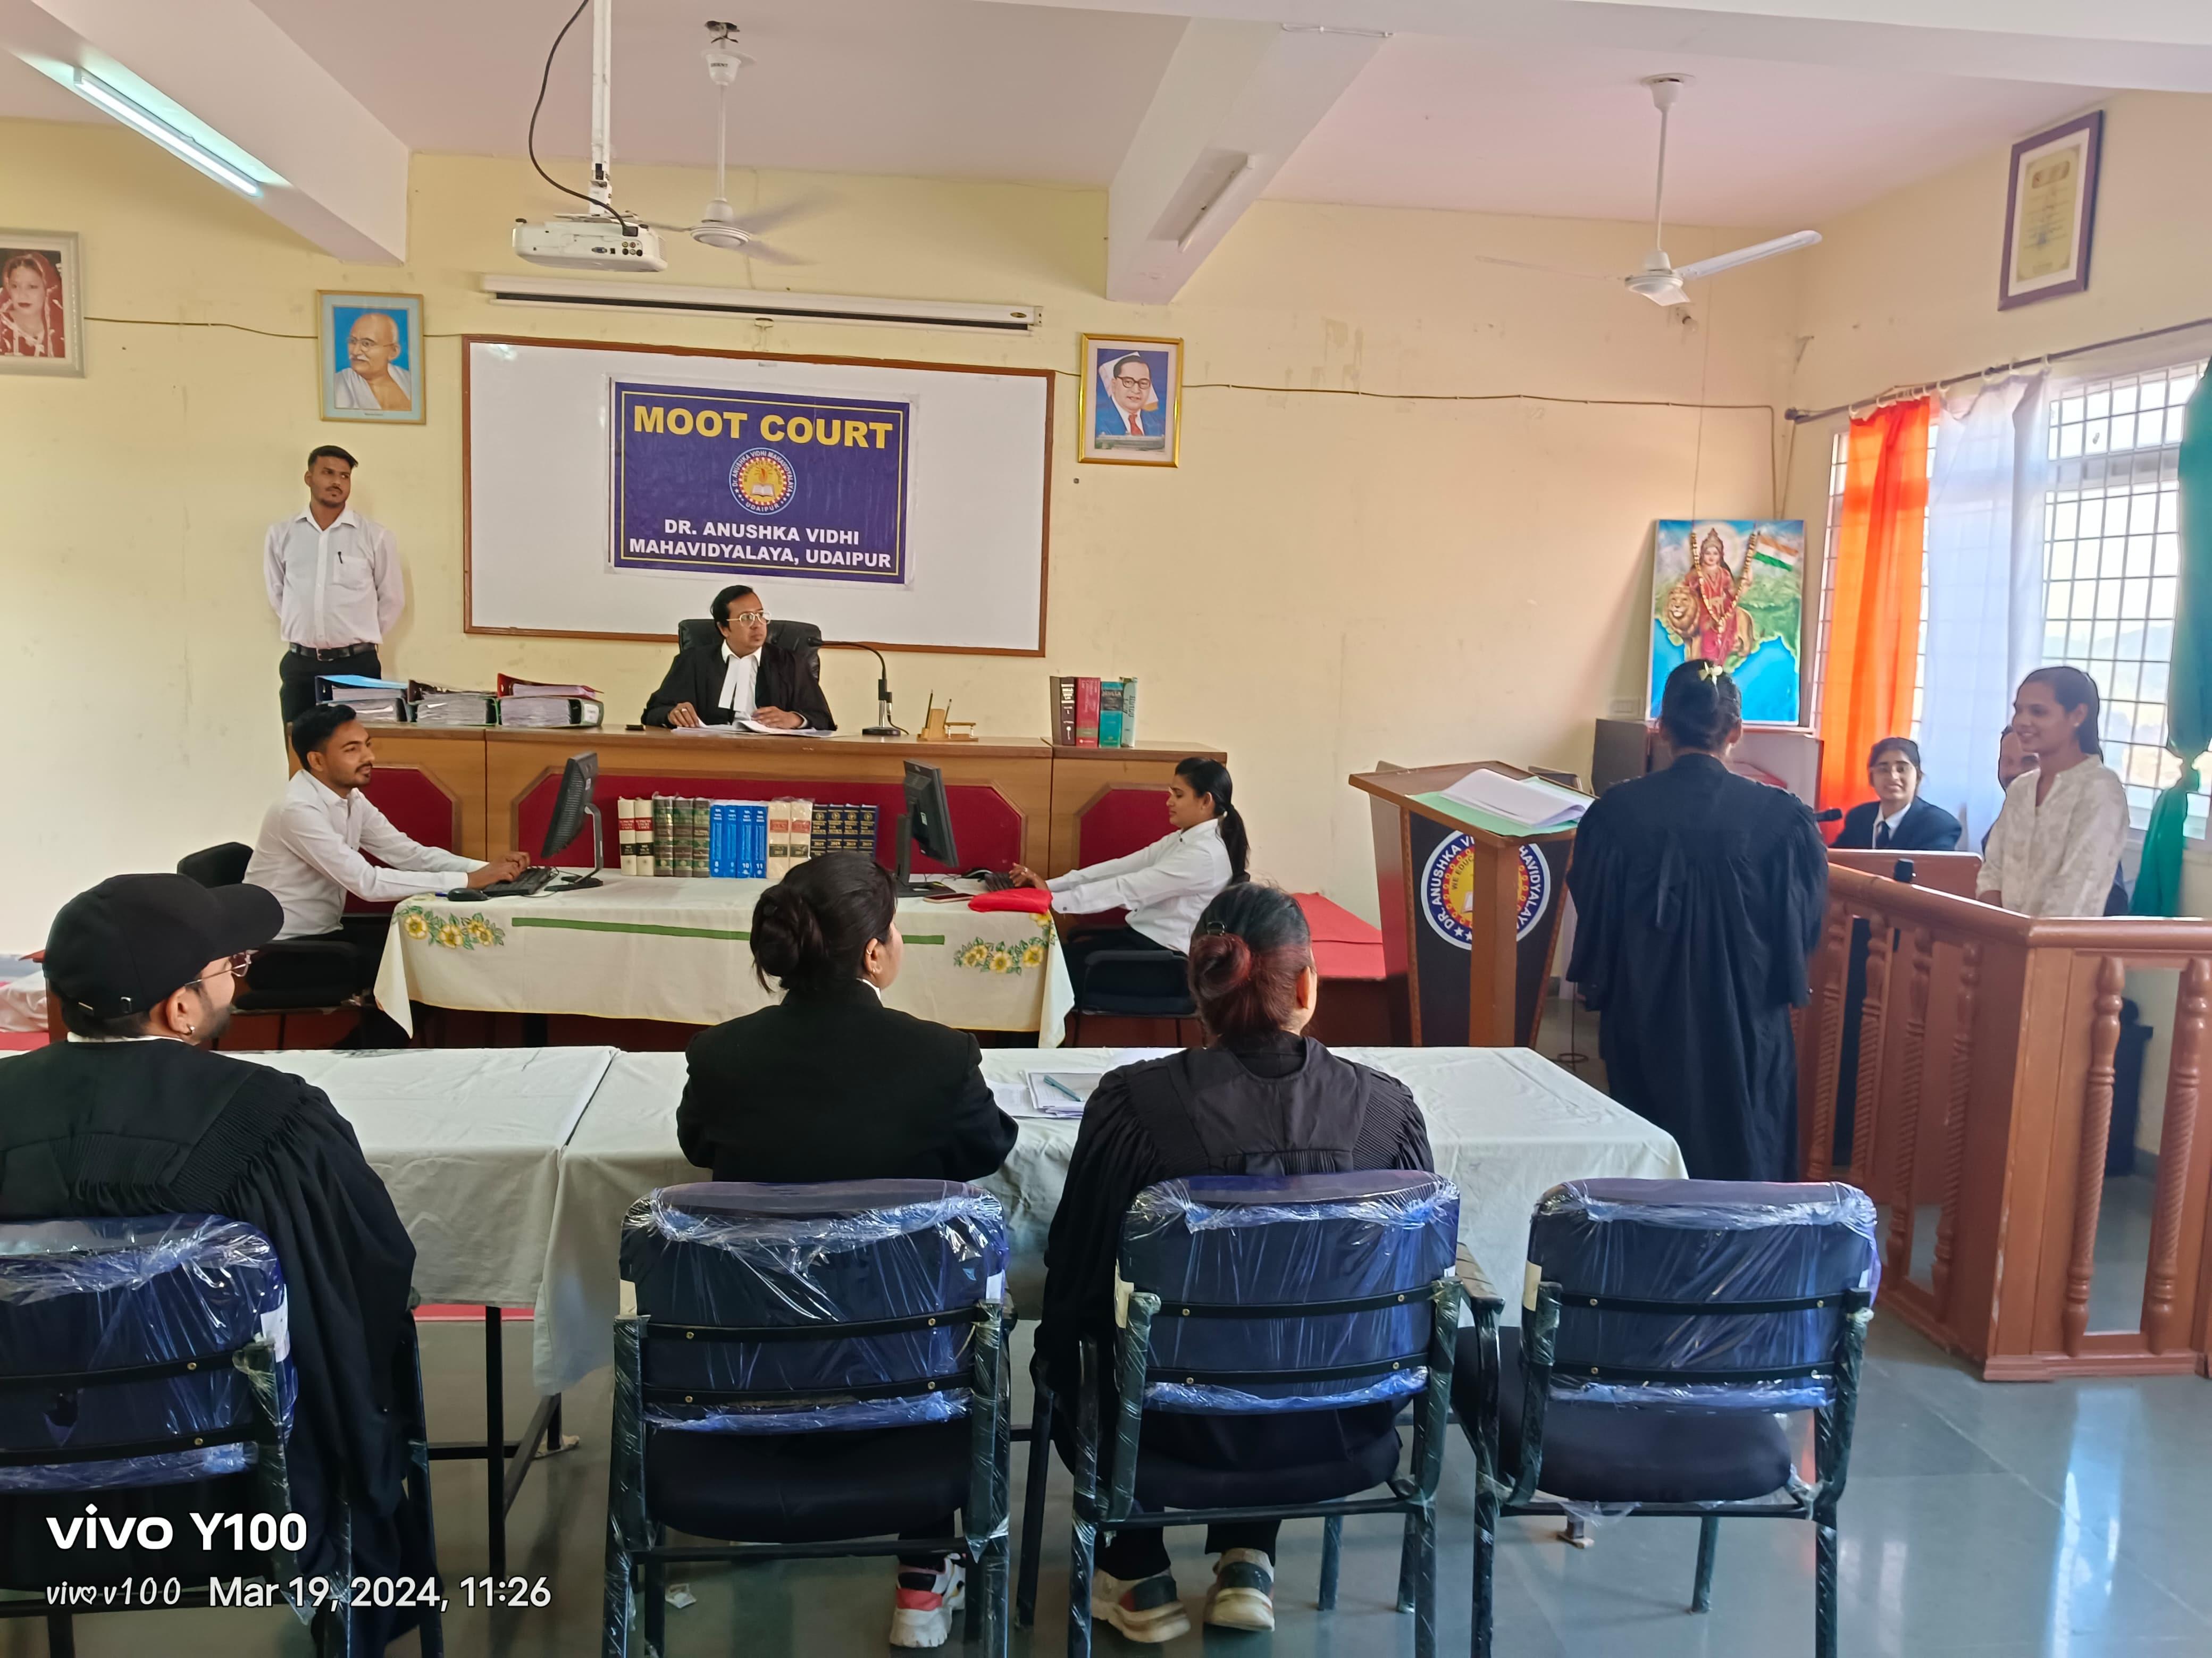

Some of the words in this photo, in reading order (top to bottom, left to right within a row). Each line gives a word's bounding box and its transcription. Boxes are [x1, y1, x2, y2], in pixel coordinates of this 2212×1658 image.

[633, 405, 748, 439] MOOT
[760, 415, 893, 449] COURT
[745, 502, 780, 512] UDAIPUR
[665, 519, 697, 535] DR.
[703, 521, 800, 542] ANUSHKA
[806, 528, 859, 545] VIDHI
[630, 538, 799, 565] MAHAVIDYALAYA,
[806, 549, 891, 567] UDAIPUR
[1430, 845, 1462, 906] ANUSHKA
[1452, 876, 1459, 890] WE
